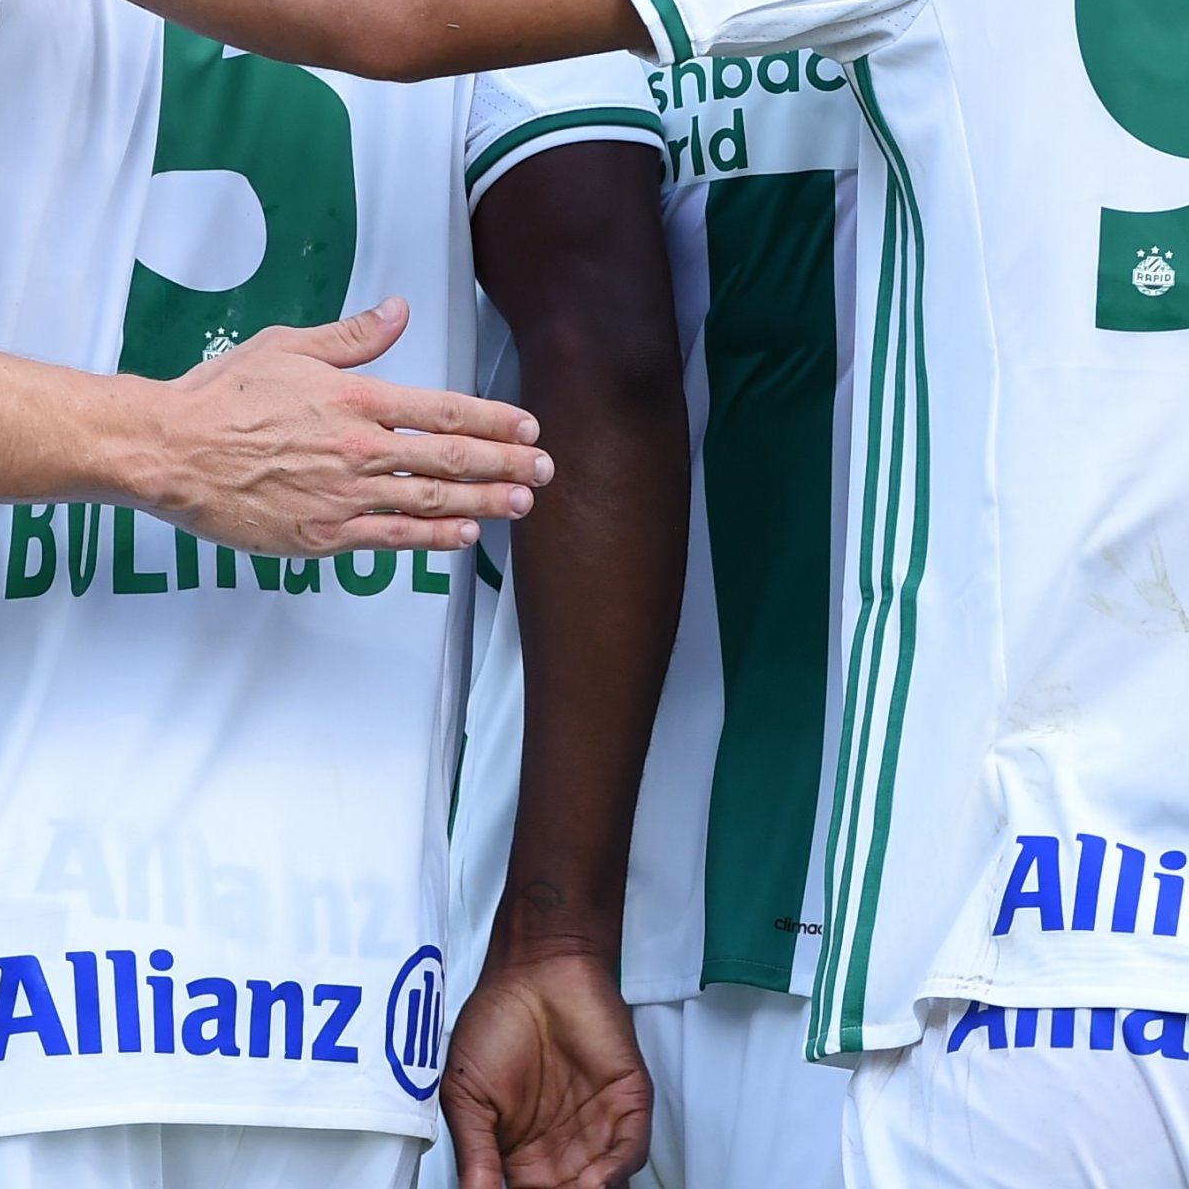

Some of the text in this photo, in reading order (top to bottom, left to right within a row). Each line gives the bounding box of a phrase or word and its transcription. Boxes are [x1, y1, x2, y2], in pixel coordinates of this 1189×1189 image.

[648, 50, 847, 113] shbac
[661, 107, 749, 183] rld
[1137, 272, 1172, 283] RAPID
[992, 832, 1188, 937] Alli
[773, 915, 823, 935] climac
